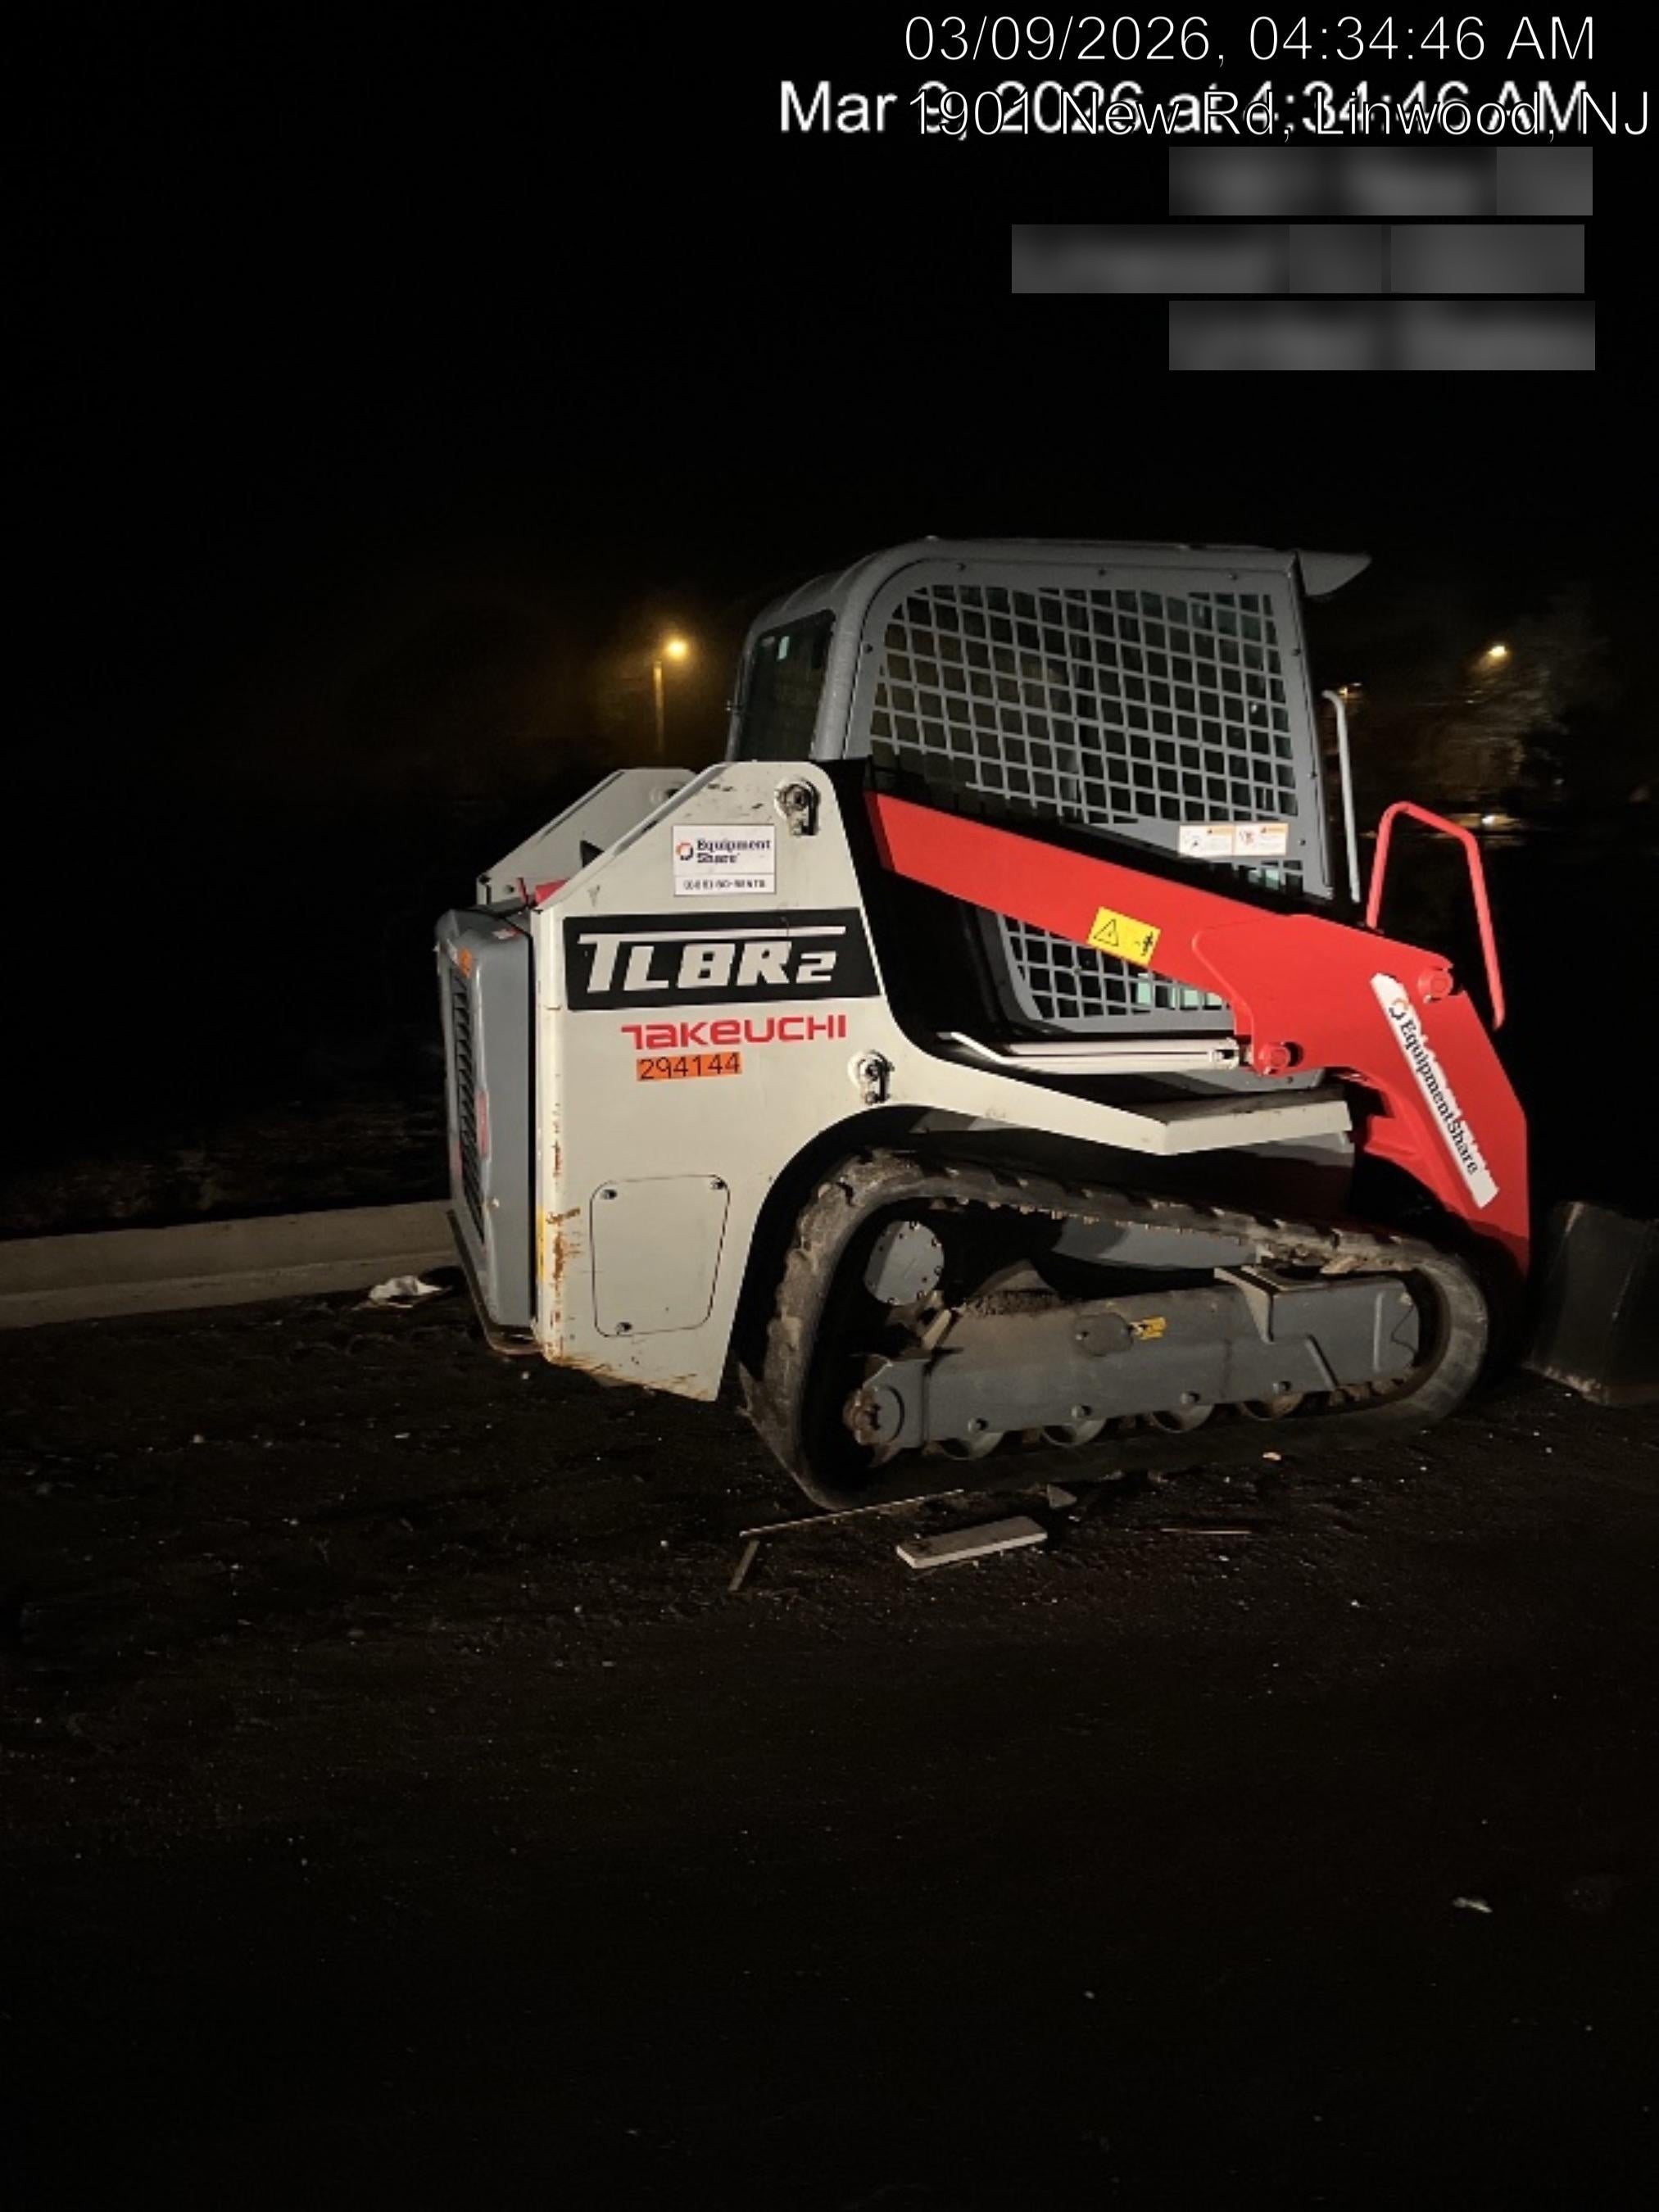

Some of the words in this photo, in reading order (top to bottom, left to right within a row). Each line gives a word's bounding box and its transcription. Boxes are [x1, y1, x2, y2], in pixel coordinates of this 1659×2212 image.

[696, 839, 771, 853] Equipment
[696, 852, 737, 863] Share
[578, 926, 846, 994] TL8R2
[640, 1052, 741, 1080] 294144
[1400, 1020, 1479, 1176] EquipmentShare
